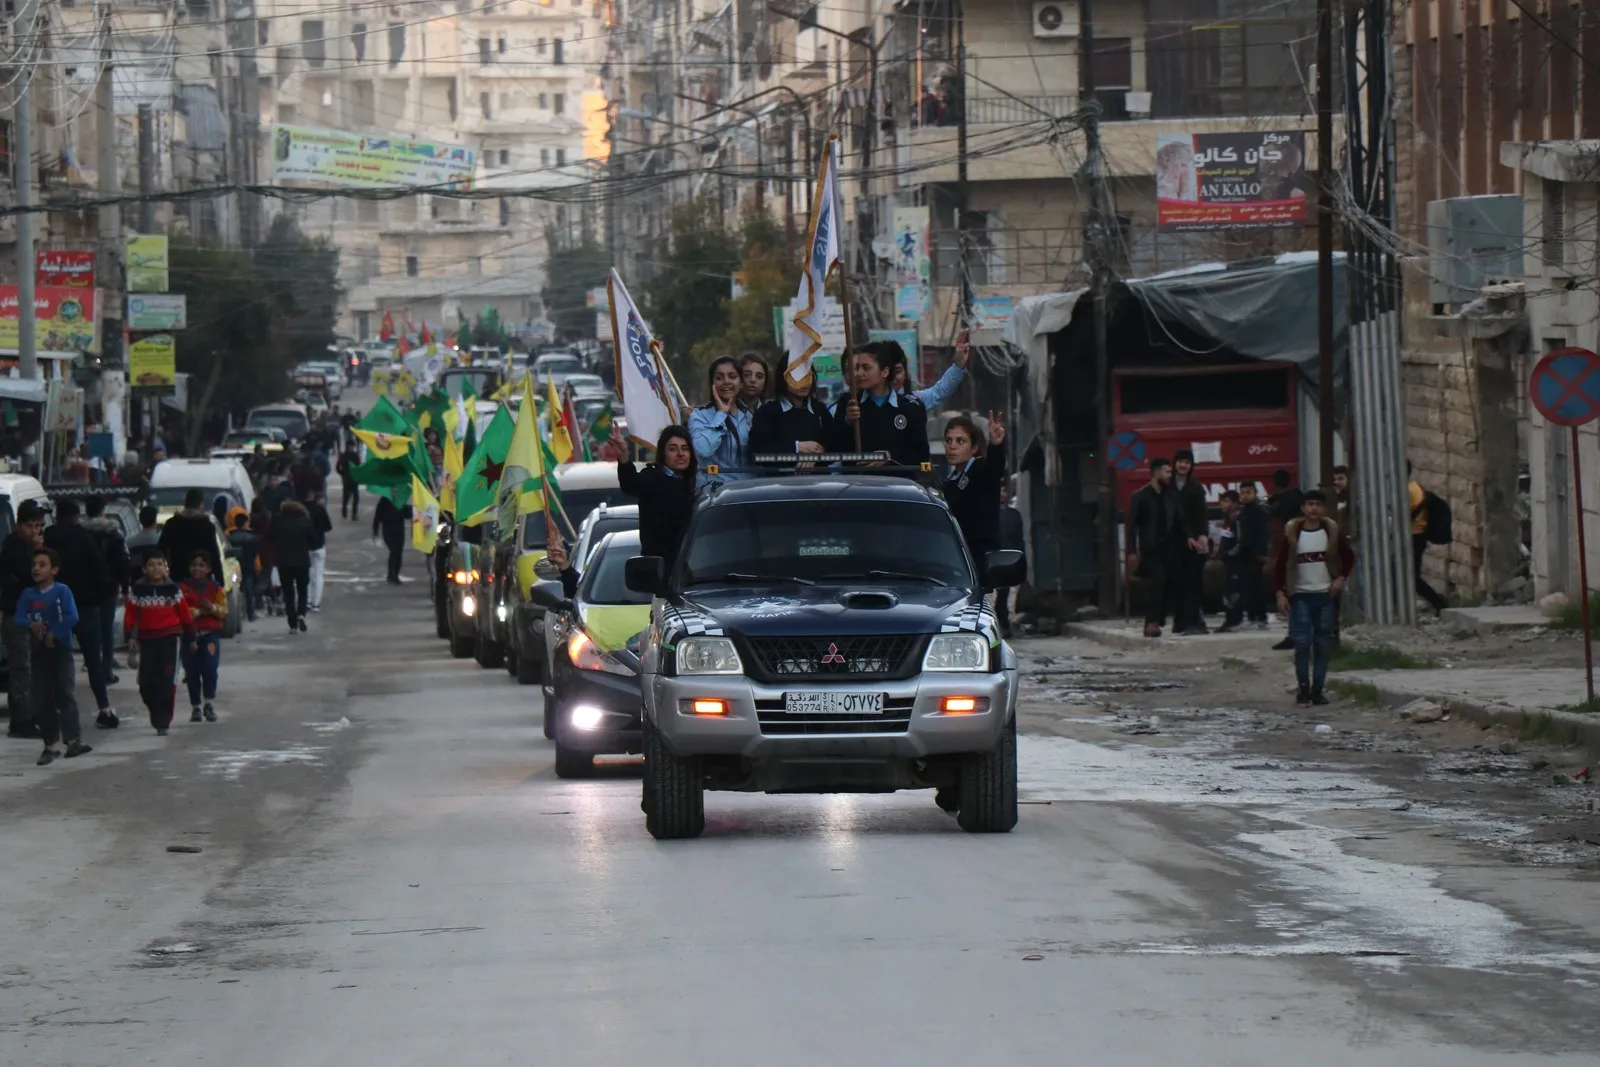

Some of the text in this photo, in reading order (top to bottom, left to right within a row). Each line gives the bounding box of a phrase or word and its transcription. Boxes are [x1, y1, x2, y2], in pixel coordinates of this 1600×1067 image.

[1263, 132, 1291, 145] مركز
[1193, 146, 1282, 168] جان كالو
[1222, 182, 1261, 197] KALO
[787, 704, 820, 712] 053774
